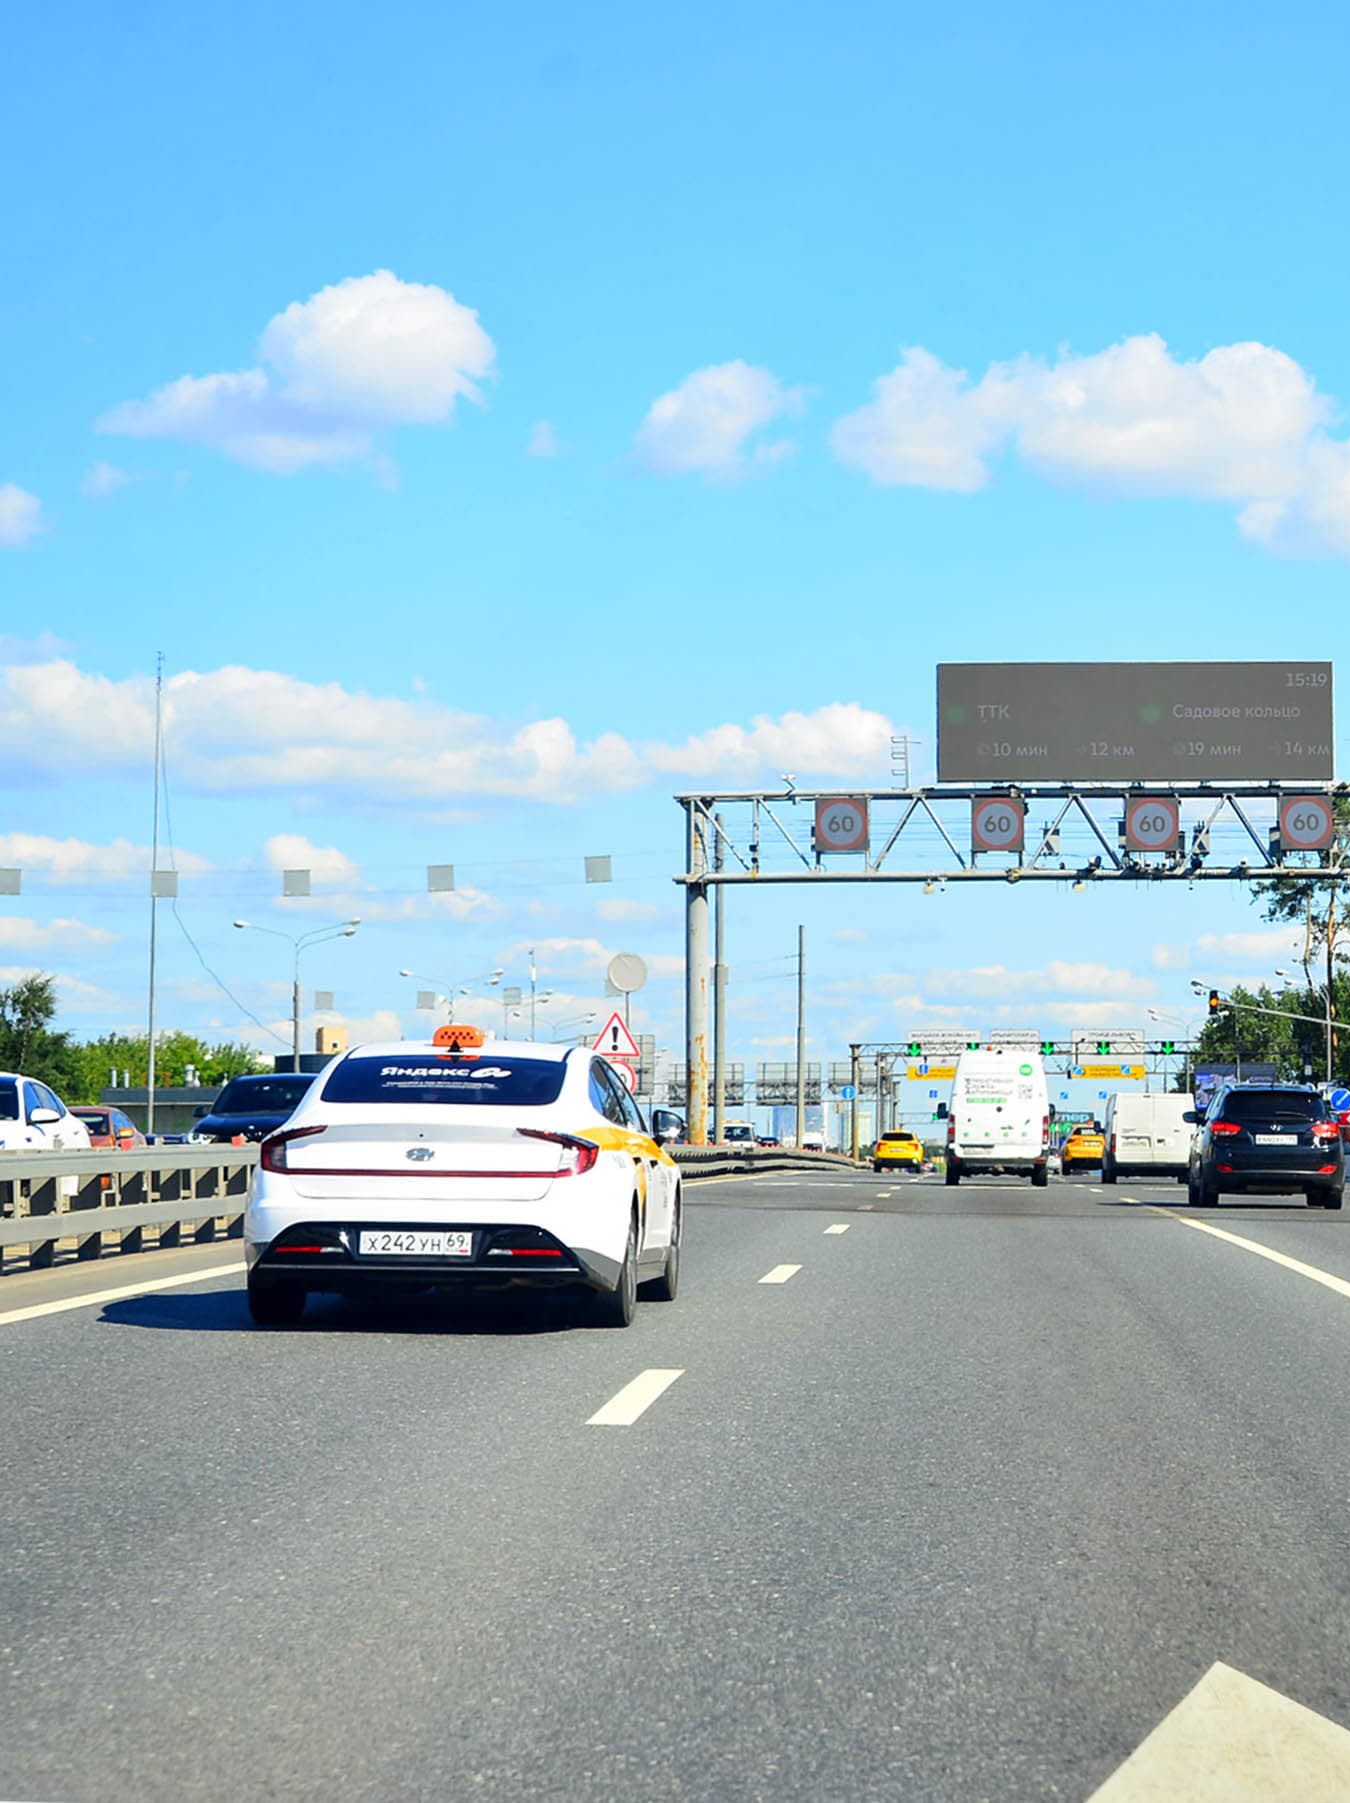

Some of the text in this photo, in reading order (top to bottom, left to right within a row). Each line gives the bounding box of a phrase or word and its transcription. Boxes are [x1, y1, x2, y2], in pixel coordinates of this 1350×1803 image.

[1285, 673, 1328, 688] 15:19
[977, 704, 1010, 719] ТТК
[1172, 704, 1301, 720] Садовое кольцо
[992, 742, 1048, 757] 10 мин
[1089, 742, 1136, 757] 12 км
[1187, 742, 1242, 757] 19 мин
[1284, 742, 1331, 757] 14 км
[827, 815, 855, 833] 60
[983, 815, 1011, 833] 60
[1138, 815, 1166, 833] 60
[1292, 813, 1320, 831] 60
[380, 1066, 470, 1077] Яндекс
[367, 1234, 466, 1252] Х242УН 69
